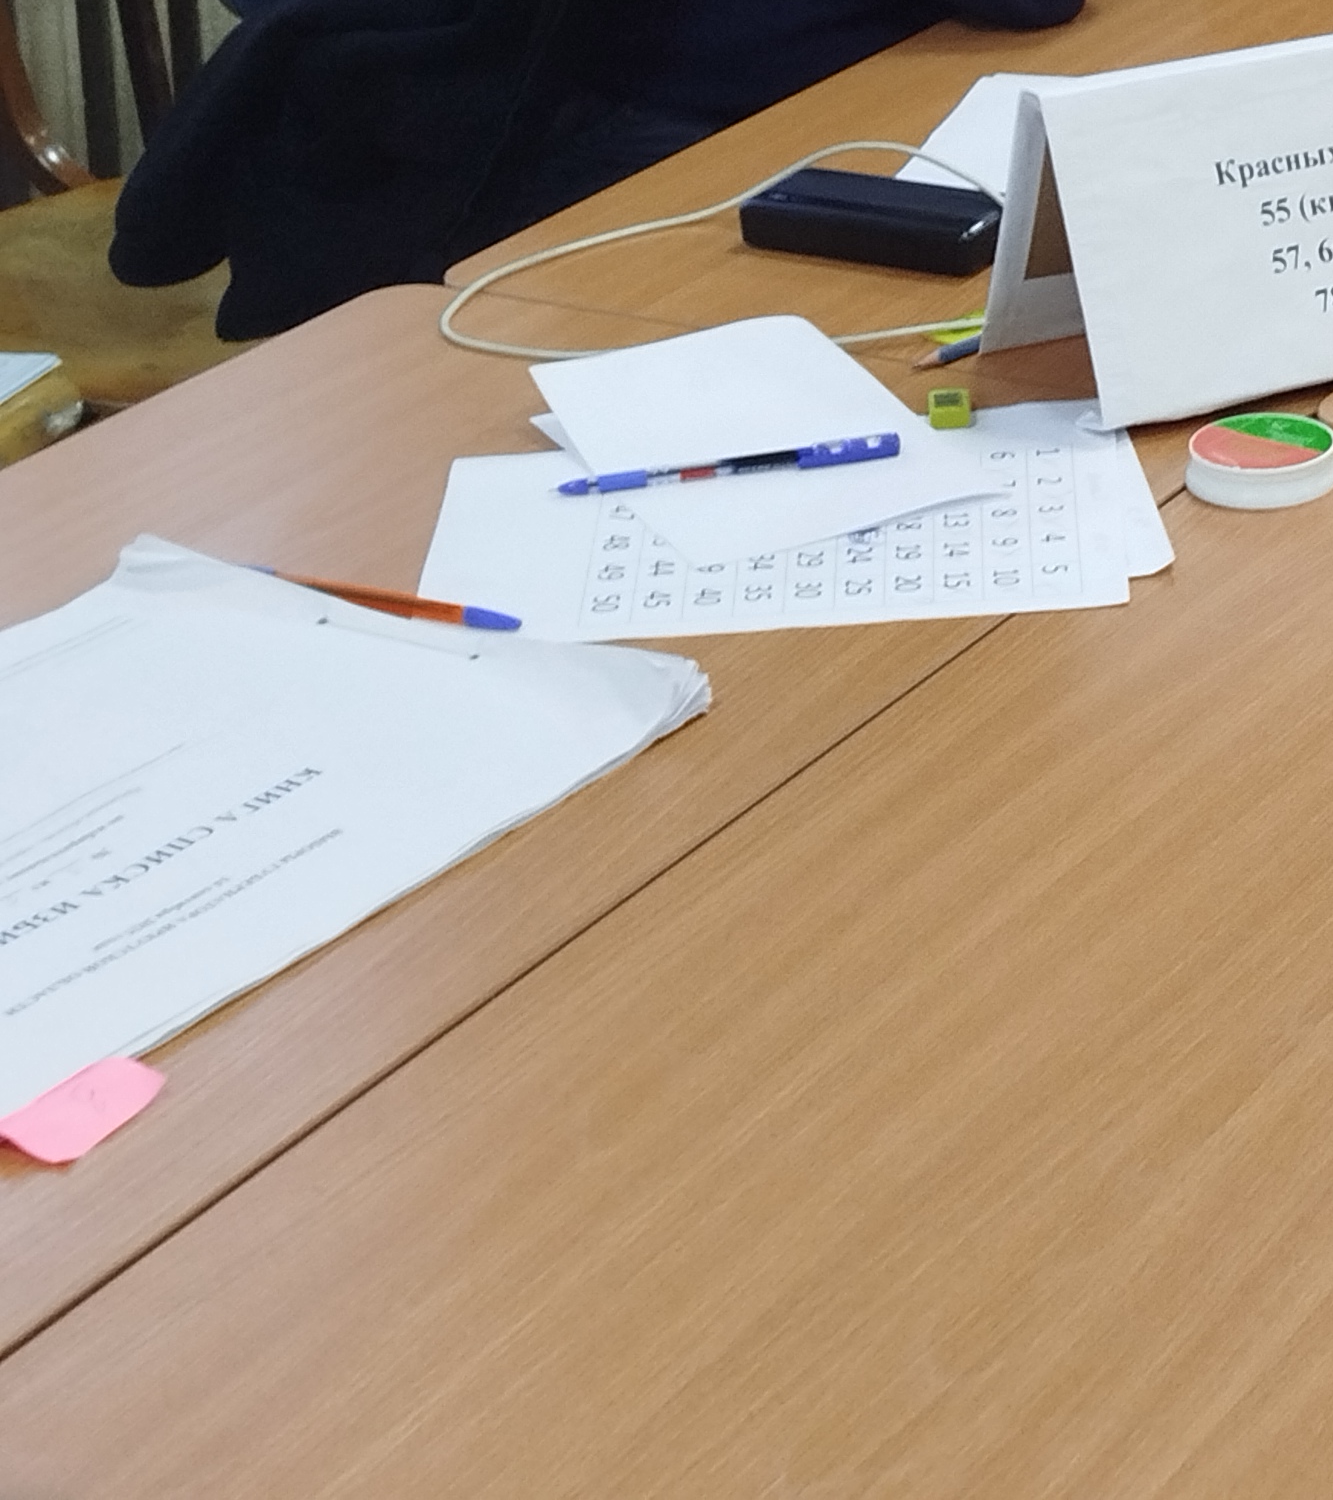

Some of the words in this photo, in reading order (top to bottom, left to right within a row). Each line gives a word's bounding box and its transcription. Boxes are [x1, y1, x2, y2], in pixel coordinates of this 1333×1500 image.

[1260, 197, 1291, 226] 55
[1272, 244, 1311, 274] 57,
[990, 451, 1015, 460] 6
[1037, 476, 1062, 485] 2
[991, 508, 1017, 518] 8
[1038, 504, 1064, 513] 3
[943, 512, 970, 528] 13
[602, 534, 630, 551] 48
[992, 537, 1018, 547] 9
[1041, 533, 1066, 542] 4
[797, 550, 824, 567] 29
[847, 547, 873, 564] 24
[895, 544, 922, 560] 19
[943, 542, 970, 558] 14
[597, 564, 625, 580] 49
[650, 559, 675, 577] 44
[1042, 564, 1068, 574] 5
[895, 574, 922, 592] 20
[944, 572, 971, 589] 15
[993, 569, 1020, 586] 10
[745, 584, 772, 601] 35
[795, 582, 822, 598] 30
[845, 579, 872, 595] 25
[591, 594, 621, 613] 50
[643, 589, 671, 608] 45
[694, 587, 722, 606] 40
[214, 766, 322, 821] КНИГА
[80, 825, 214, 897] СПИСКА
